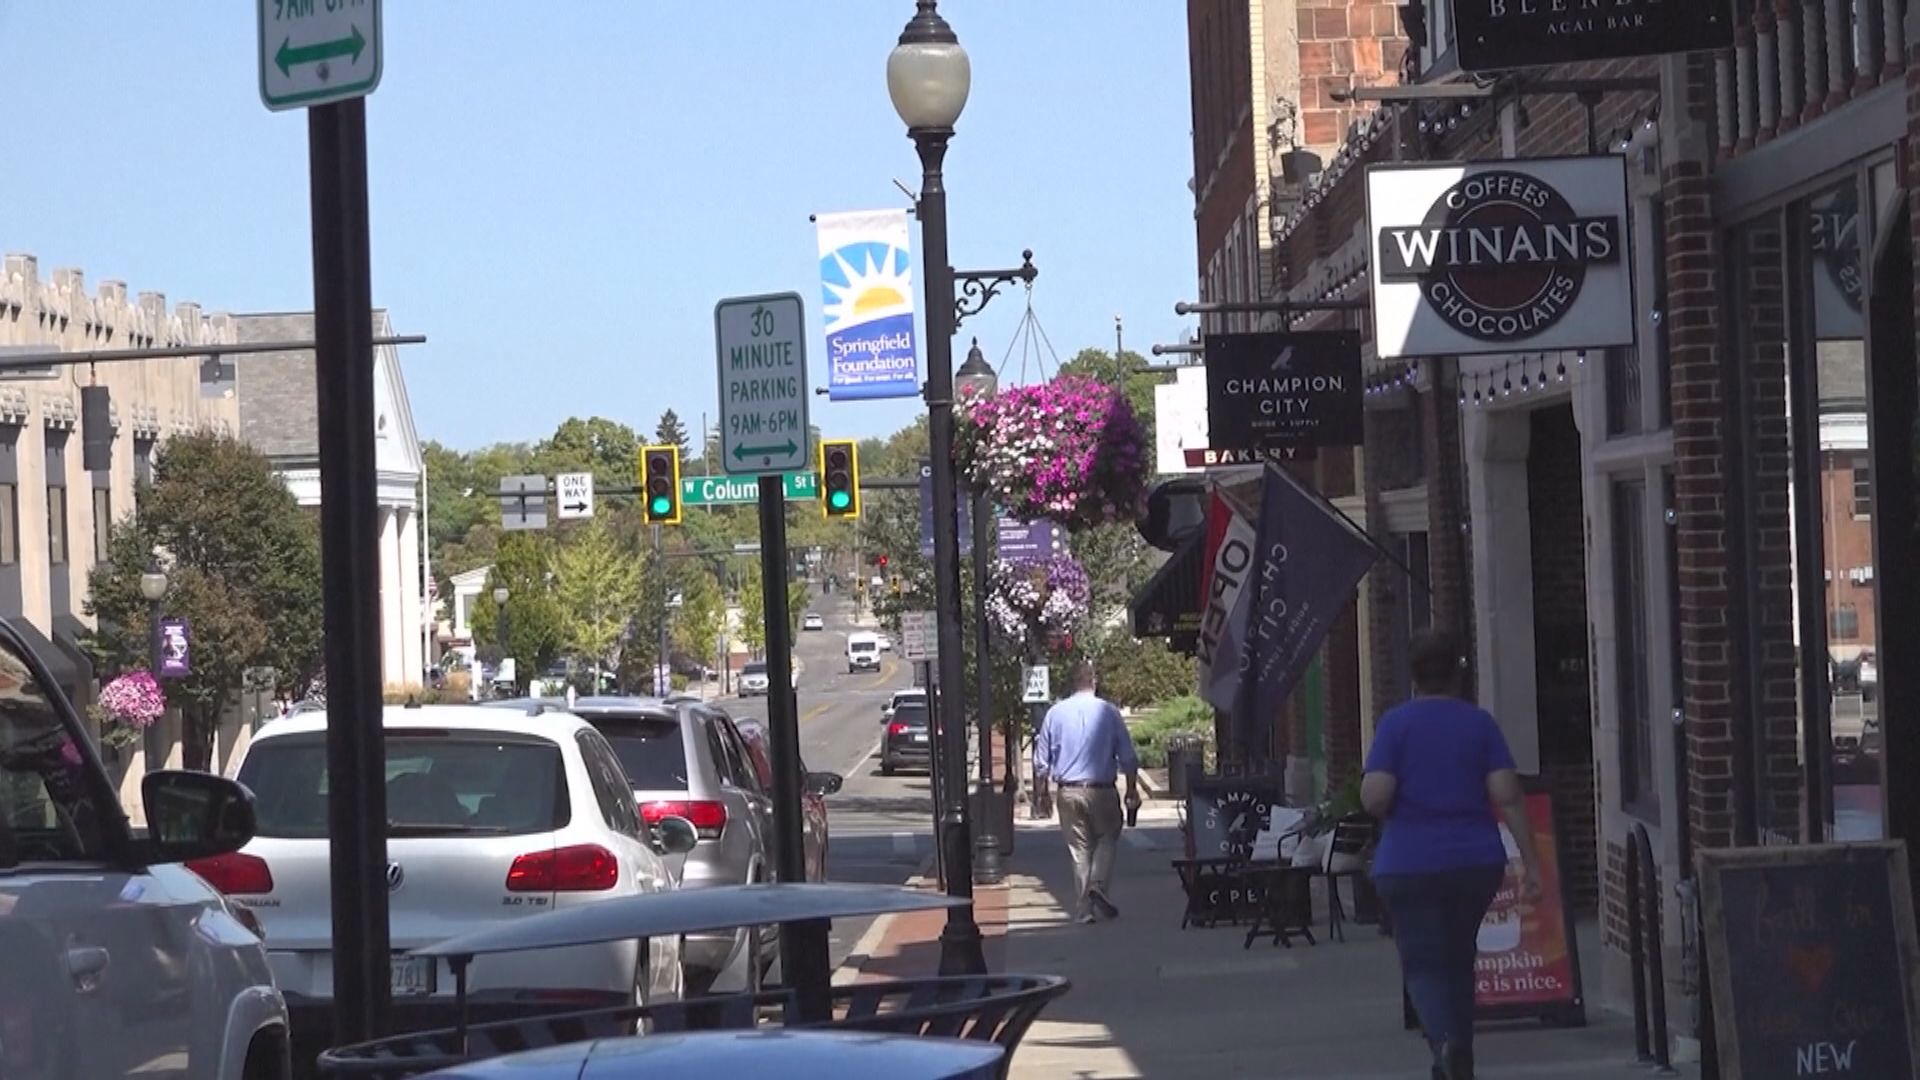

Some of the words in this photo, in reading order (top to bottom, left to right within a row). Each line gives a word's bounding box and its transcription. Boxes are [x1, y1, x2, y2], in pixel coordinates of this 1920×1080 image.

[1546, 19, 1594, 35] ACAI
[1607, 14, 1645, 30] BAR
[1446, 176, 1550, 210] COFFEES
[1391, 221, 1611, 269] WINANS
[1430, 275, 1574, 335] CHOCOLATES
[750, 309, 775, 337] 30
[832, 331, 911, 358] Springfield
[731, 342, 793, 371] MINUTE
[832, 353, 915, 374] Foundation
[731, 376, 797, 403] PARKING
[1226, 375, 1343, 395] CHAMPION
[1259, 398, 1310, 414] CITY
[730, 409, 798, 435] 9AM-6PM
[1204, 447, 1297, 464] BAKERY
[563, 476, 586, 487] ONE
[684, 481, 695, 493] W
[794, 475, 807, 488] St
[564, 487, 588, 498] WAY
[1025, 668, 1045, 679] ONE
[1026, 679, 1046, 688] WAY
[1493, 975, 1511, 992] is
[1514, 971, 1563, 991] nice.
[1796, 1040, 1857, 1076] NEW
